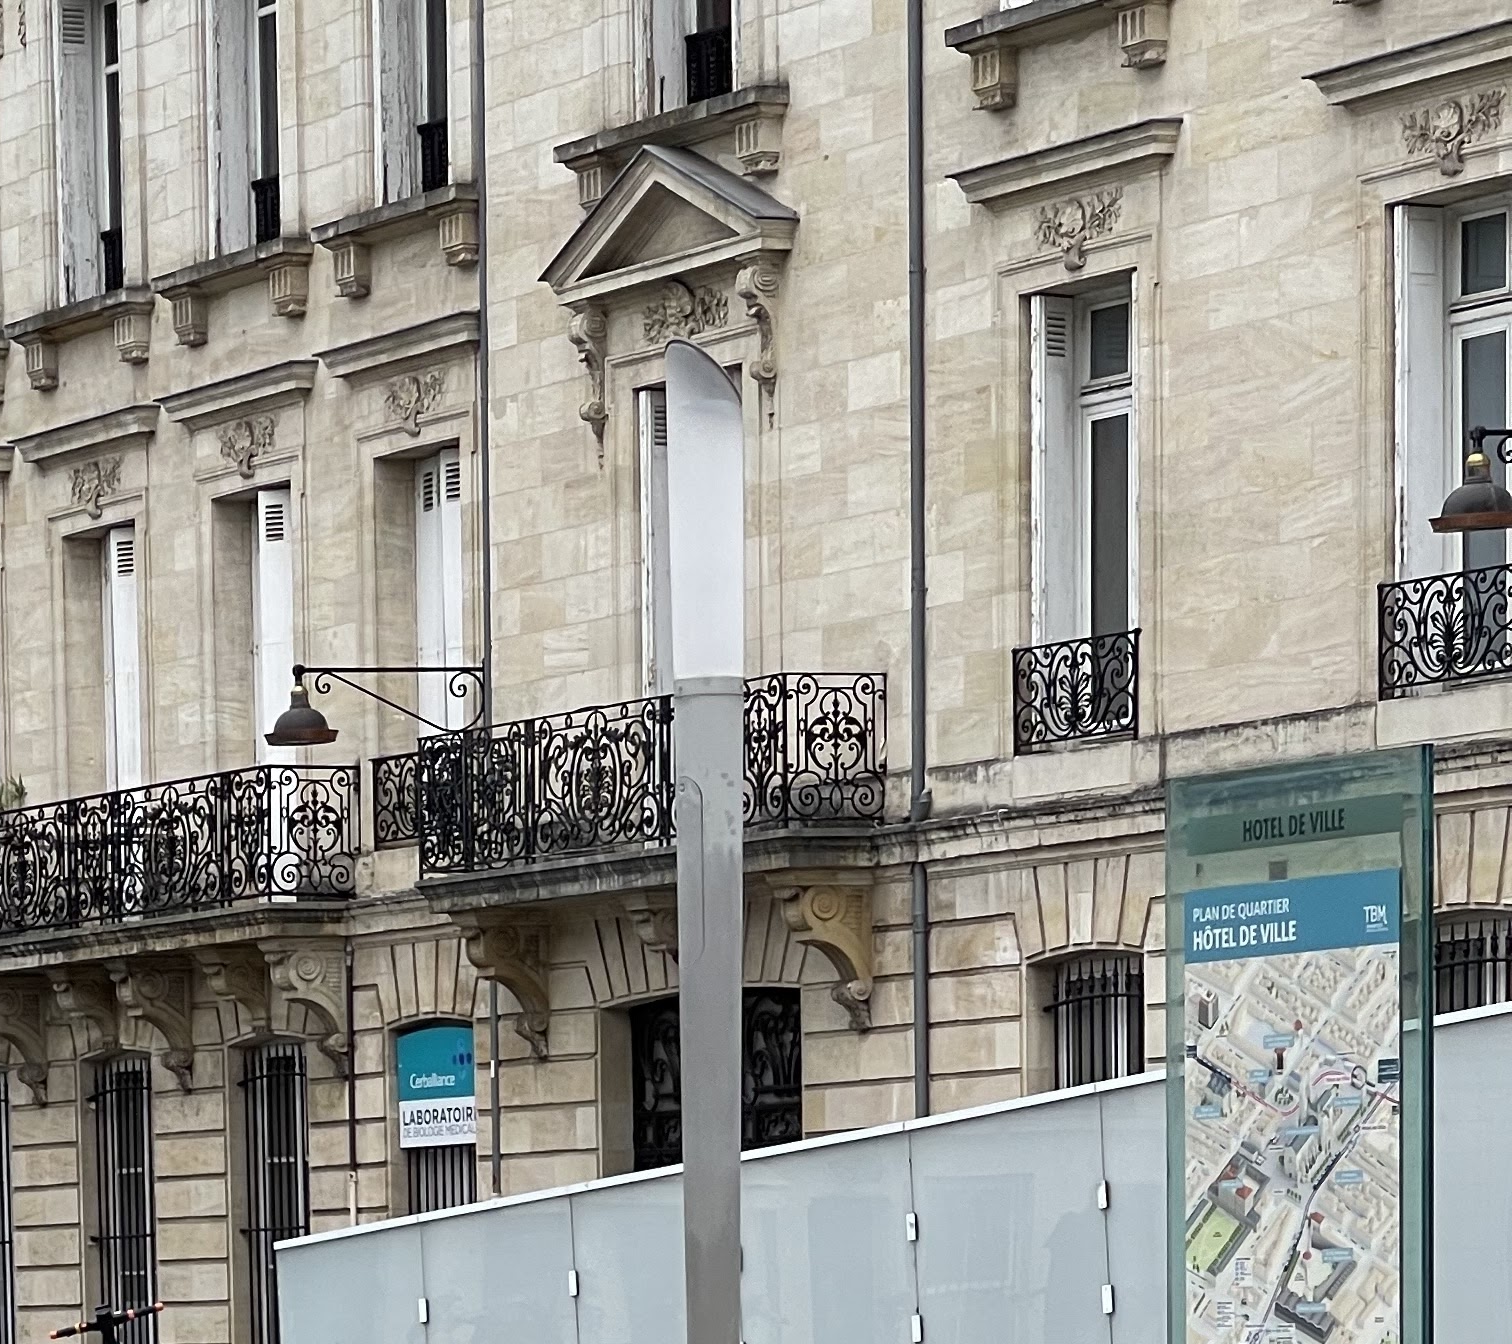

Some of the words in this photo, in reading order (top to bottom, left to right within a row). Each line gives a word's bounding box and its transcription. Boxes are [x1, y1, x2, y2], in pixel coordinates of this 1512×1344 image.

[1288, 813, 1305, 835] DE
[1309, 808, 1345, 833] VILLE
[1192, 906, 1220, 922] PLAN
[1221, 904, 1236, 920] DE
[1238, 898, 1290, 918] QUARTIER
[1363, 905, 1388, 925] TBM
[1193, 926, 1237, 951] HÔTEL
[1239, 925, 1258, 945] DE
[1260, 920, 1297, 943] VILLE
